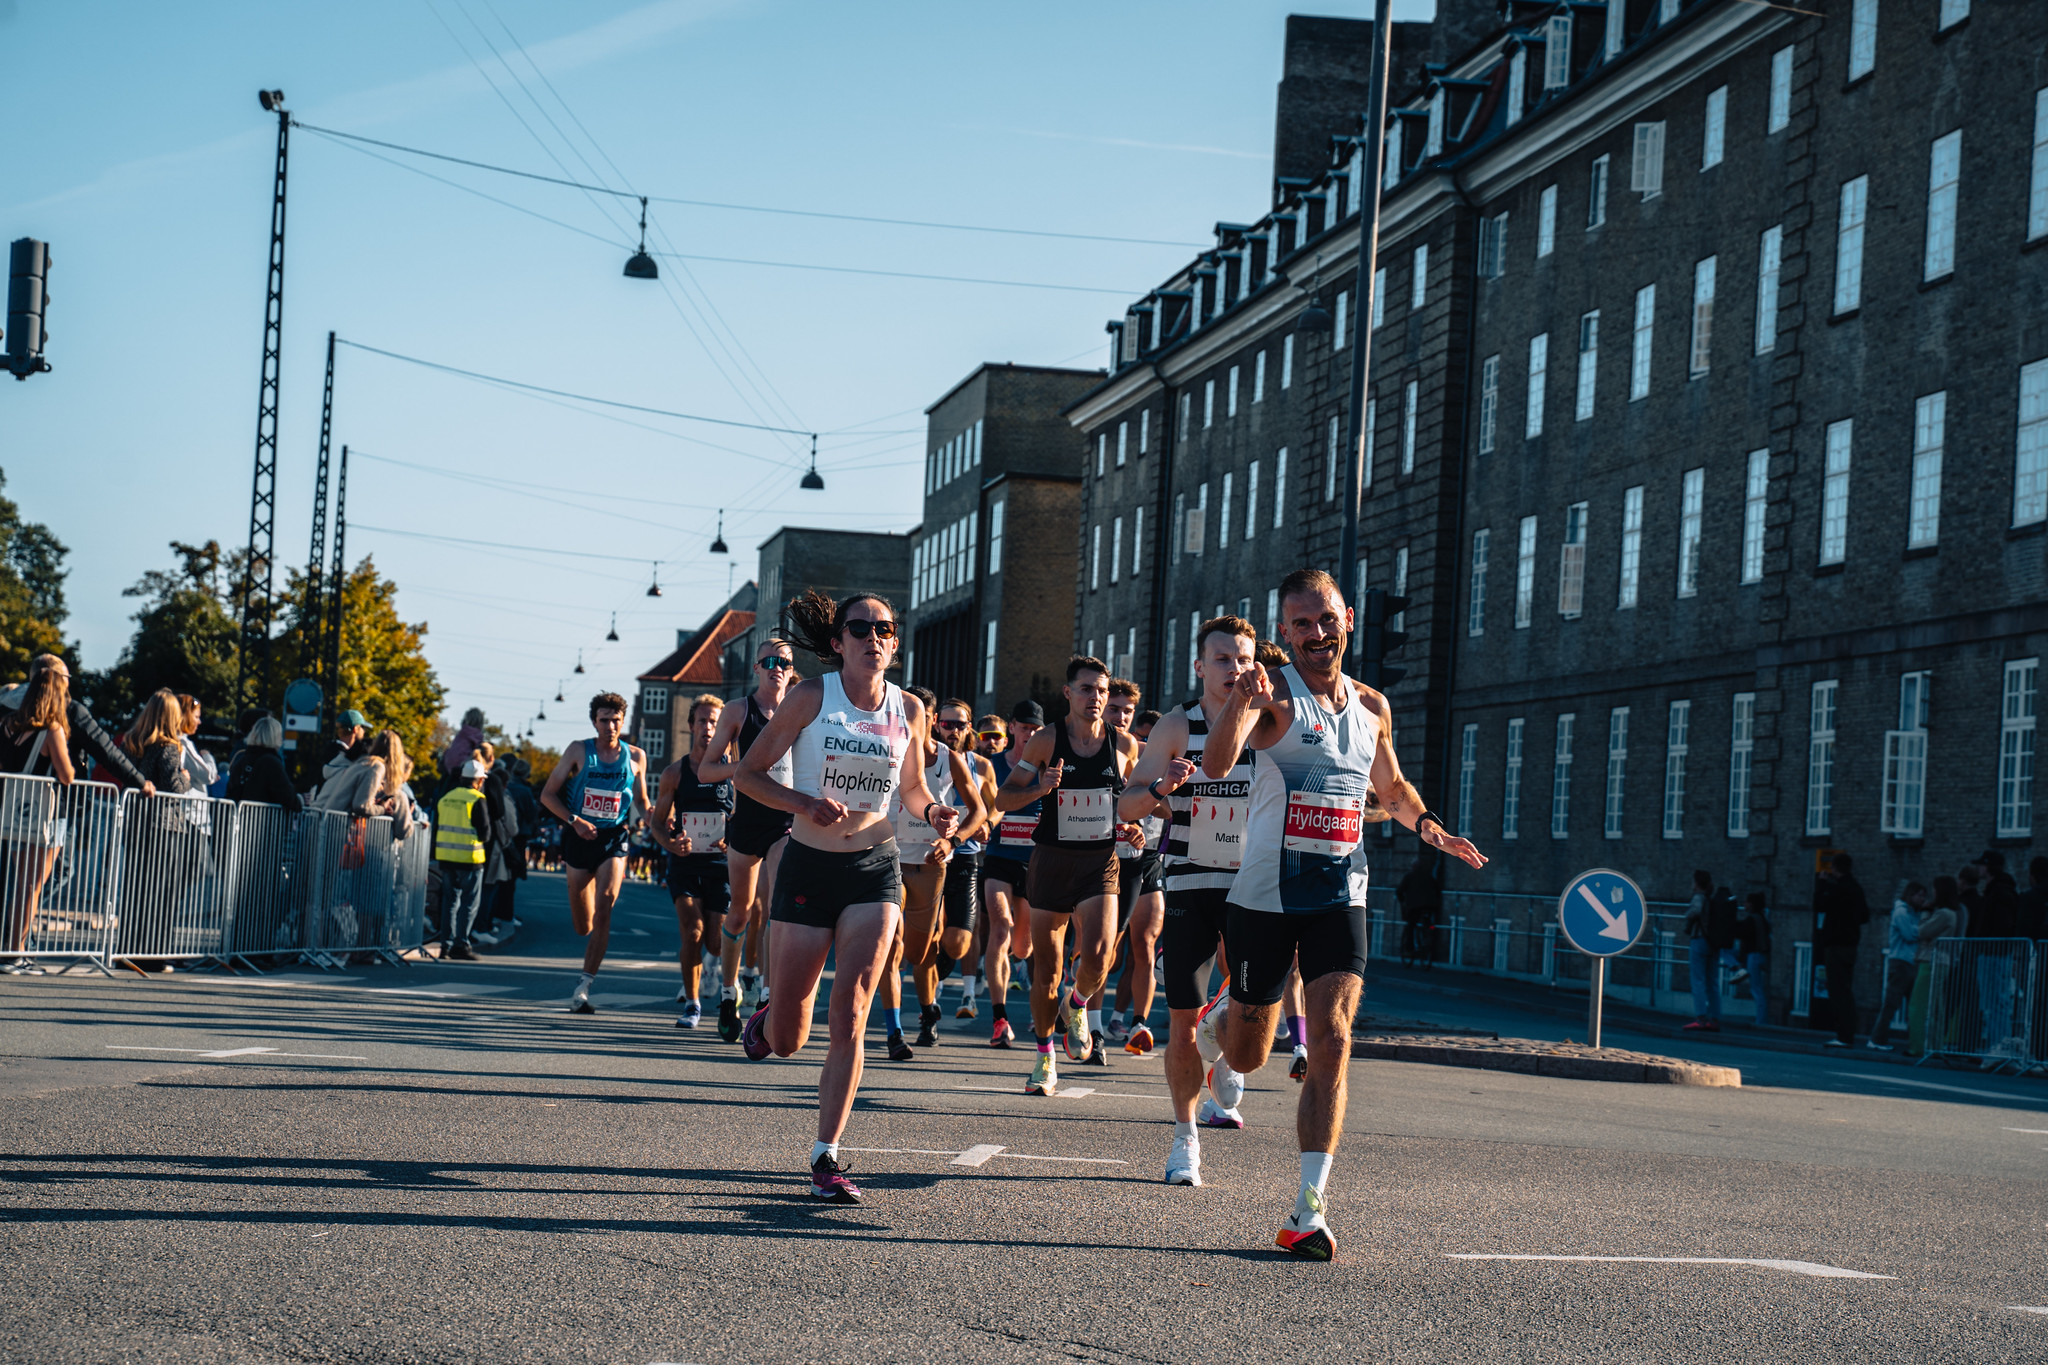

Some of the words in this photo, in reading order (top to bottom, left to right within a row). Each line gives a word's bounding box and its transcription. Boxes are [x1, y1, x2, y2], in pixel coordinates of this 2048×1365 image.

[823, 767, 892, 795] Hopkins
[584, 794, 620, 813] Dolan
[1067, 815, 1105, 823] Athanasios
[1288, 807, 1359, 833] Hyldgaard
[1215, 832, 1240, 844] Matt
